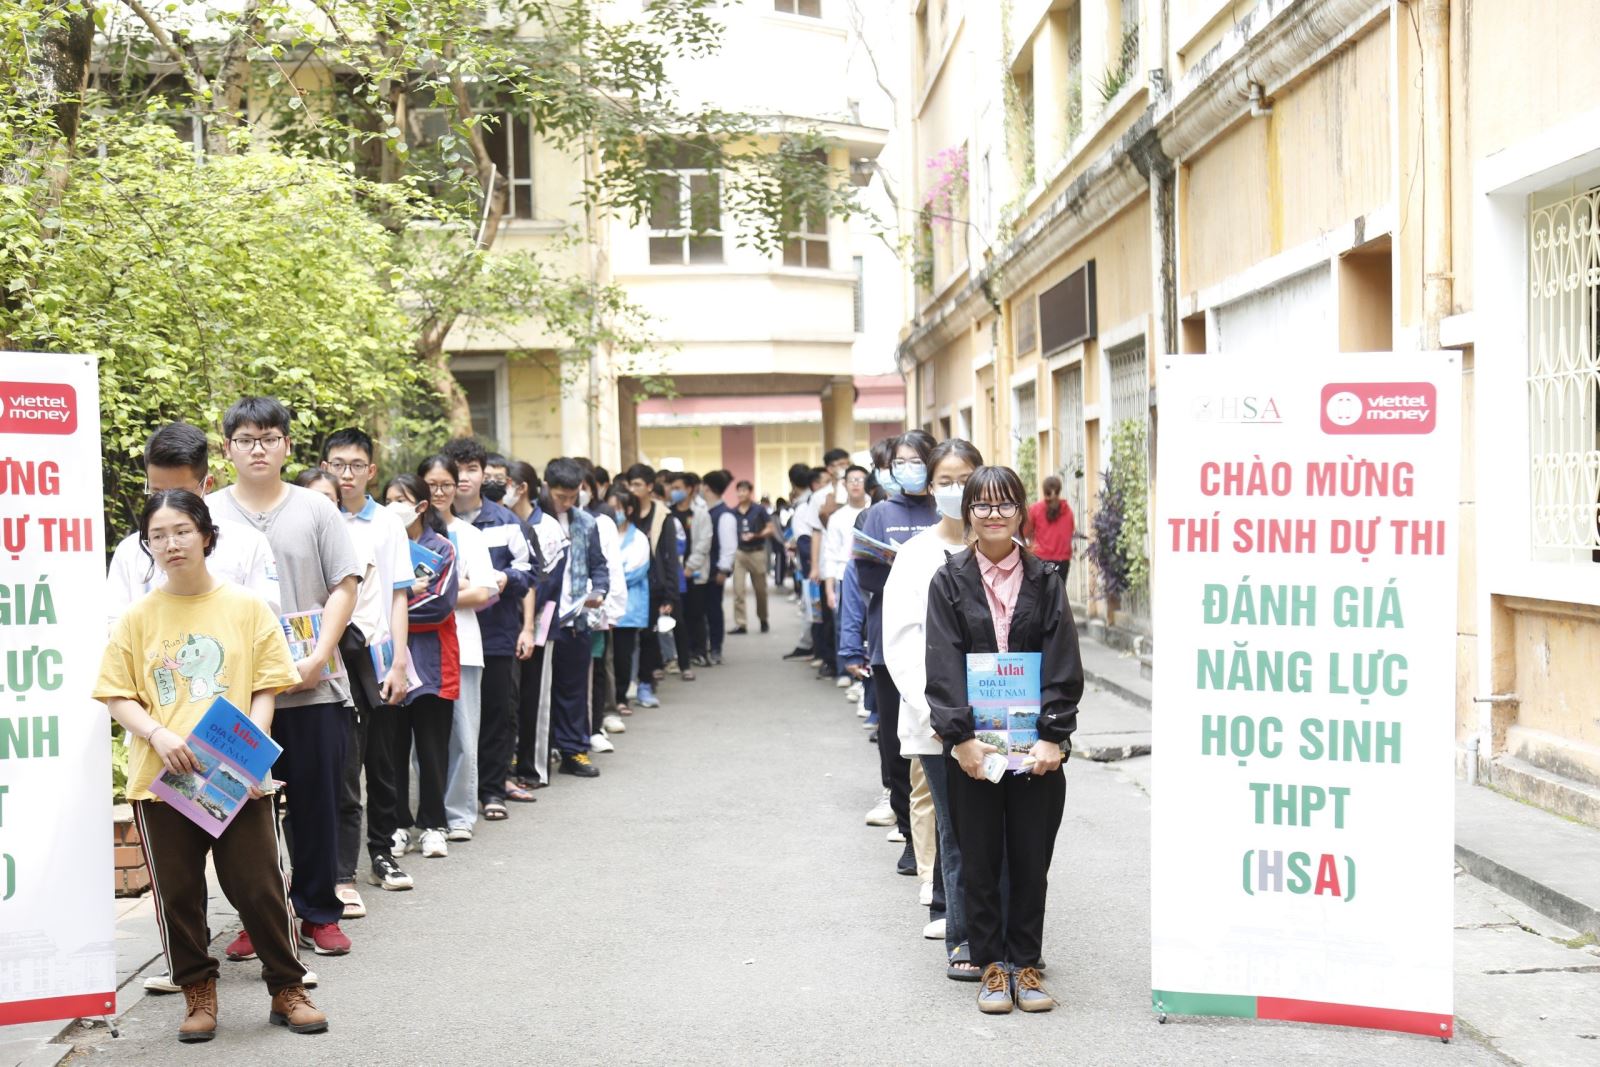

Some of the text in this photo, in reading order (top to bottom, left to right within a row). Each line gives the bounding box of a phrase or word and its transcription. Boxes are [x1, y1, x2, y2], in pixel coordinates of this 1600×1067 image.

[9, 395, 68, 408] viettel
[9, 408, 71, 423] money
[1220, 396, 1283, 419] HSA
[1366, 409, 1430, 422] money
[1367, 395, 1428, 407] viettel
[1200, 454, 1414, 497] CHÀO MỪNG
[38, 517, 94, 552] THI
[1168, 511, 1446, 563] THÍ SINH DỰ THI
[1202, 575, 1405, 629] ĐÁNH GIÁ
[0, 645, 63, 702] ỰC
[996, 663, 1024, 676] Atlat
[1196, 641, 1408, 705] NĂNG LỰC
[1005, 689, 1026, 697] NAM
[1201, 714, 1402, 767] HỌC SINH
[1249, 782, 1351, 830] THPT
[1242, 849, 1356, 903] (HSA)
